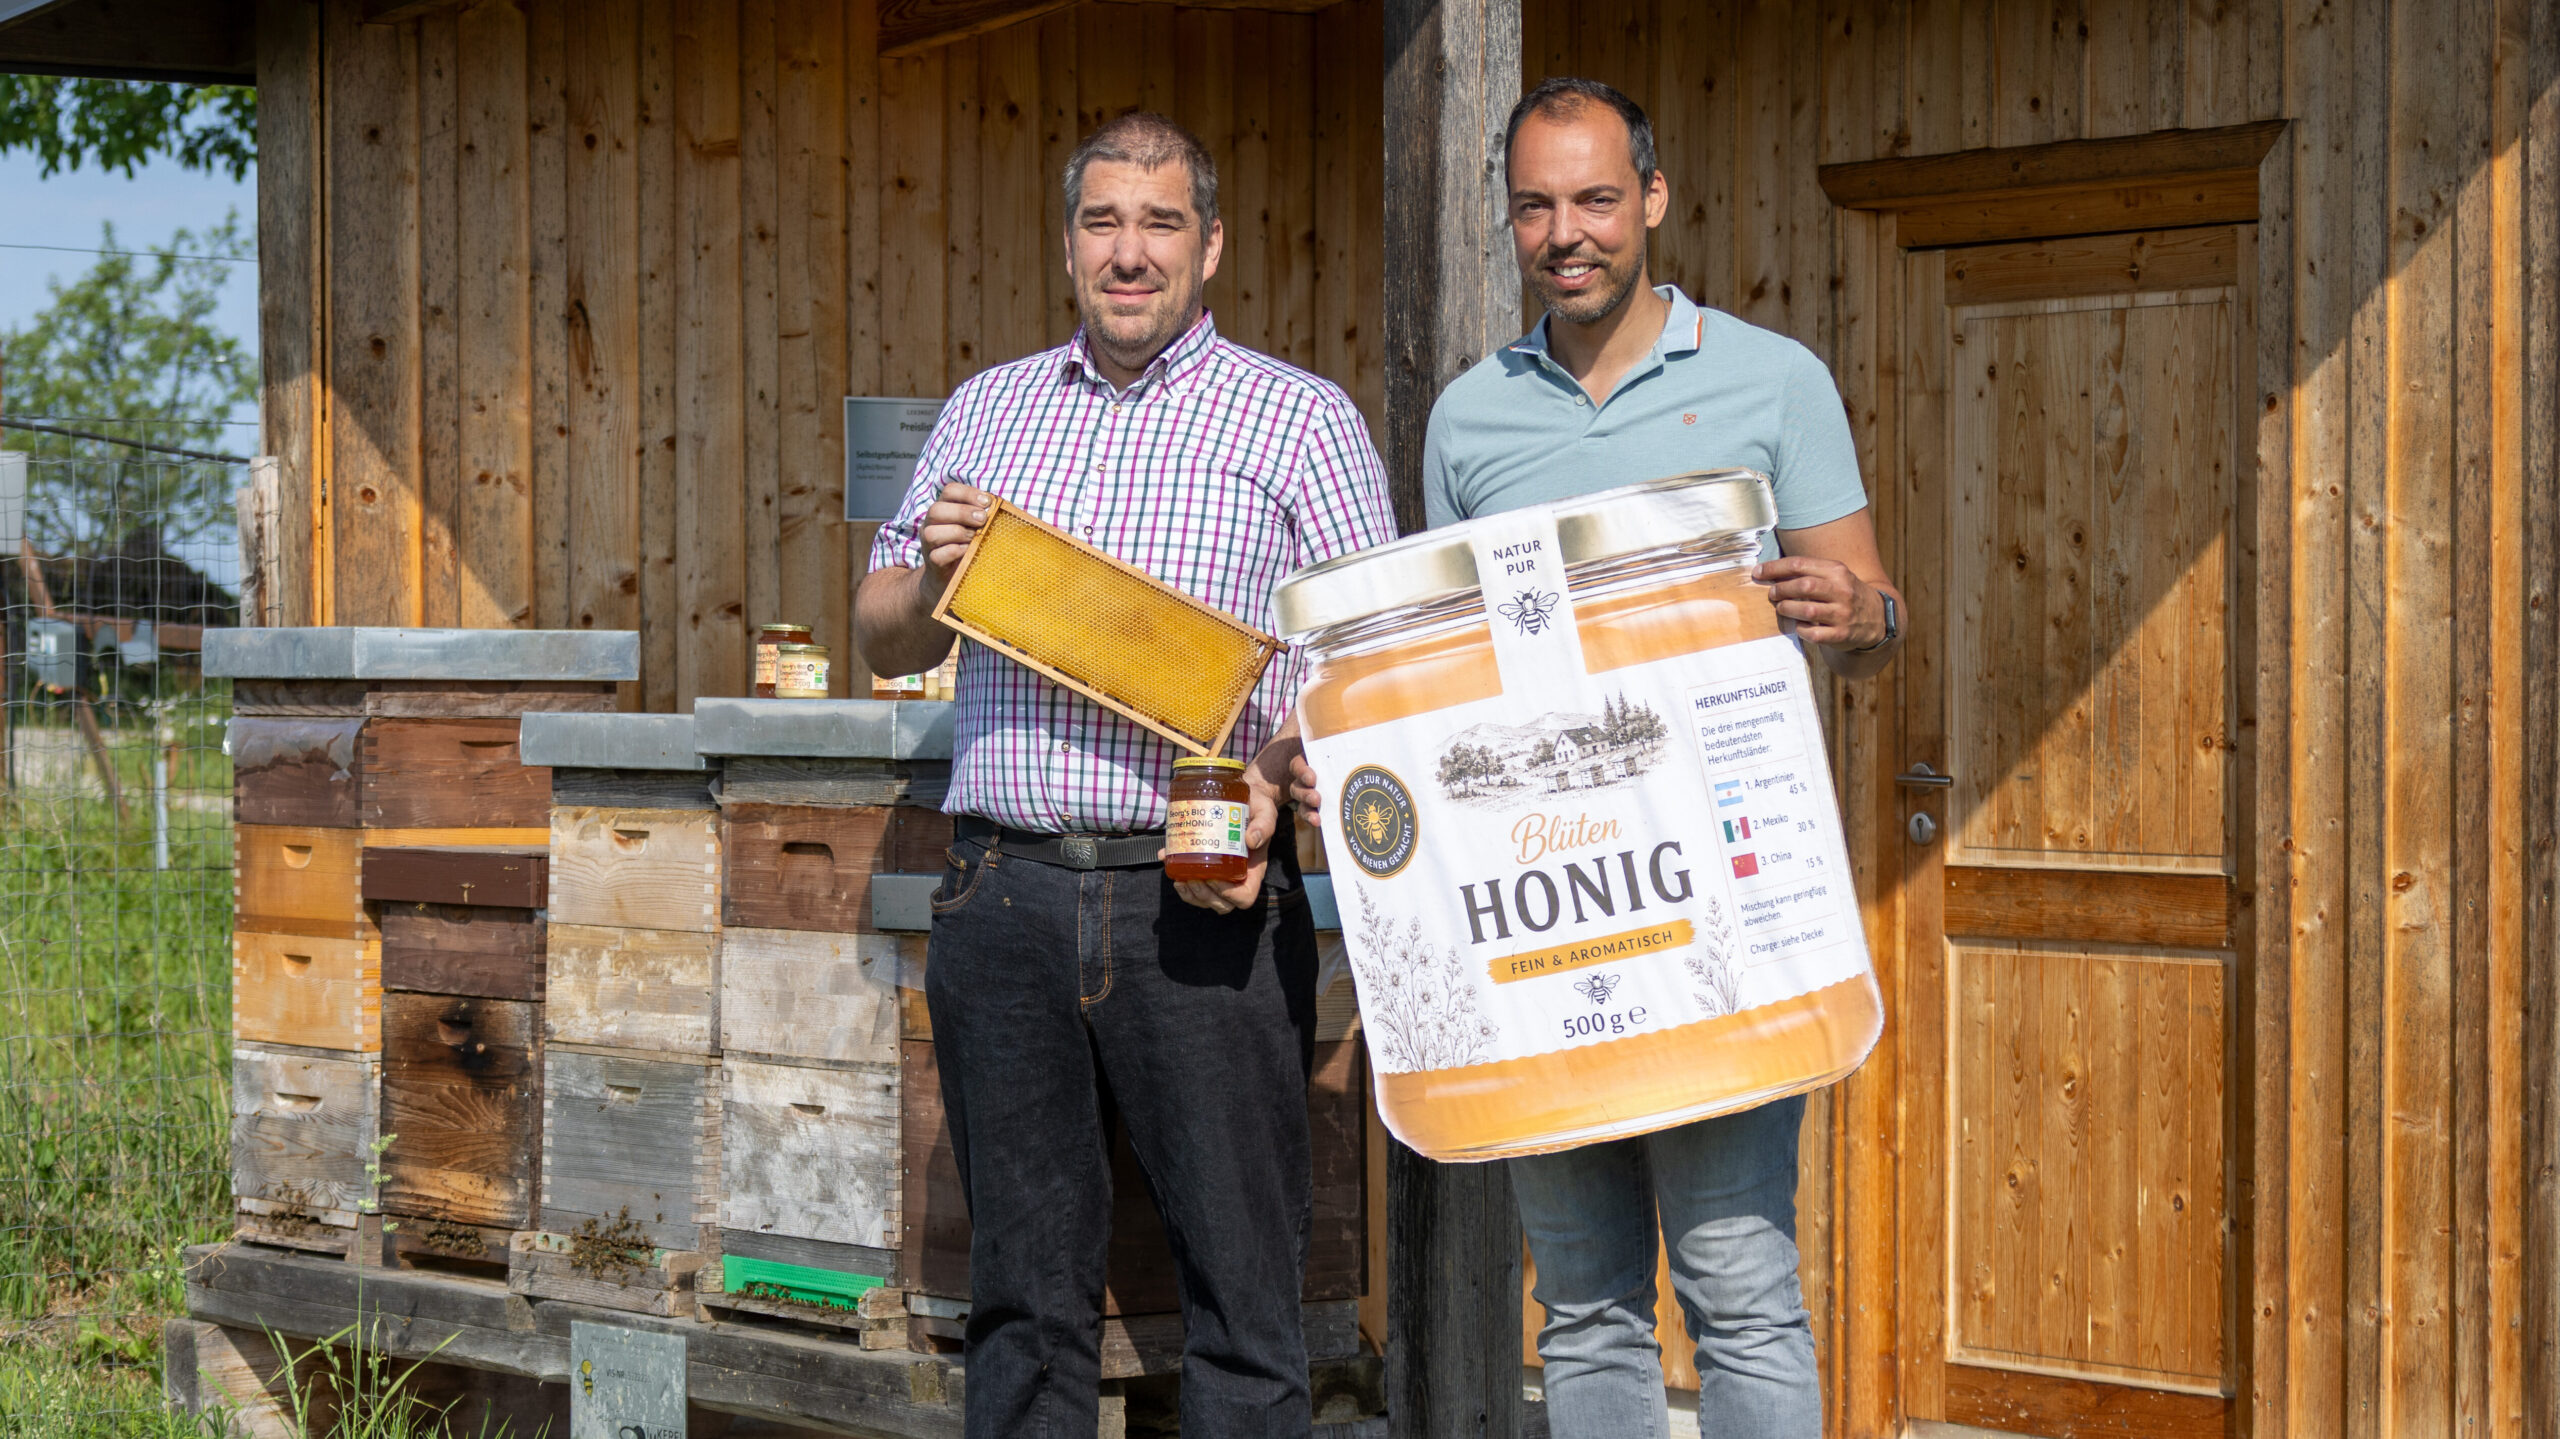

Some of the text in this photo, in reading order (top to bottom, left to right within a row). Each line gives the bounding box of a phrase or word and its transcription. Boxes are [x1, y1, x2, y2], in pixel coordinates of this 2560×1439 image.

[900, 422, 934, 432] Preislist
[1493, 540, 1542, 560] NATUR
[1506, 560, 1536, 576] PUR
[1695, 681, 1788, 710] HERKUNFTSLÄNDER
[1701, 711, 1785, 737] Die drei mengenmäßig
[1704, 731, 1763, 751] bedeutendsten
[1745, 772, 1795, 790] 1. Argentinien
[1789, 784, 1799, 794] 45
[1348, 778, 1363, 800] LIEBE
[1364, 775, 1380, 784] ZUR
[1382, 779, 1407, 809] NATUR
[1191, 808, 1206, 816] BIO
[1753, 814, 1789, 830] 2. Mexiko
[1797, 821, 1807, 832] 30
[1190, 839, 1220, 849] 1000g
[1349, 824, 1412, 869] VON BIENEN GEMACHT
[1511, 813, 1622, 864] Blüten
[1761, 851, 1792, 866] 3. China
[1806, 857, 1815, 868] 15
[1459, 841, 1694, 944] HONIG
[1741, 885, 1827, 912] Mischung kann geringfügig
[1781, 936, 1800, 947] siehe
[1801, 928, 1825, 942] Deckel
[1511, 931, 1673, 975] FEIN & AROMATISCH
